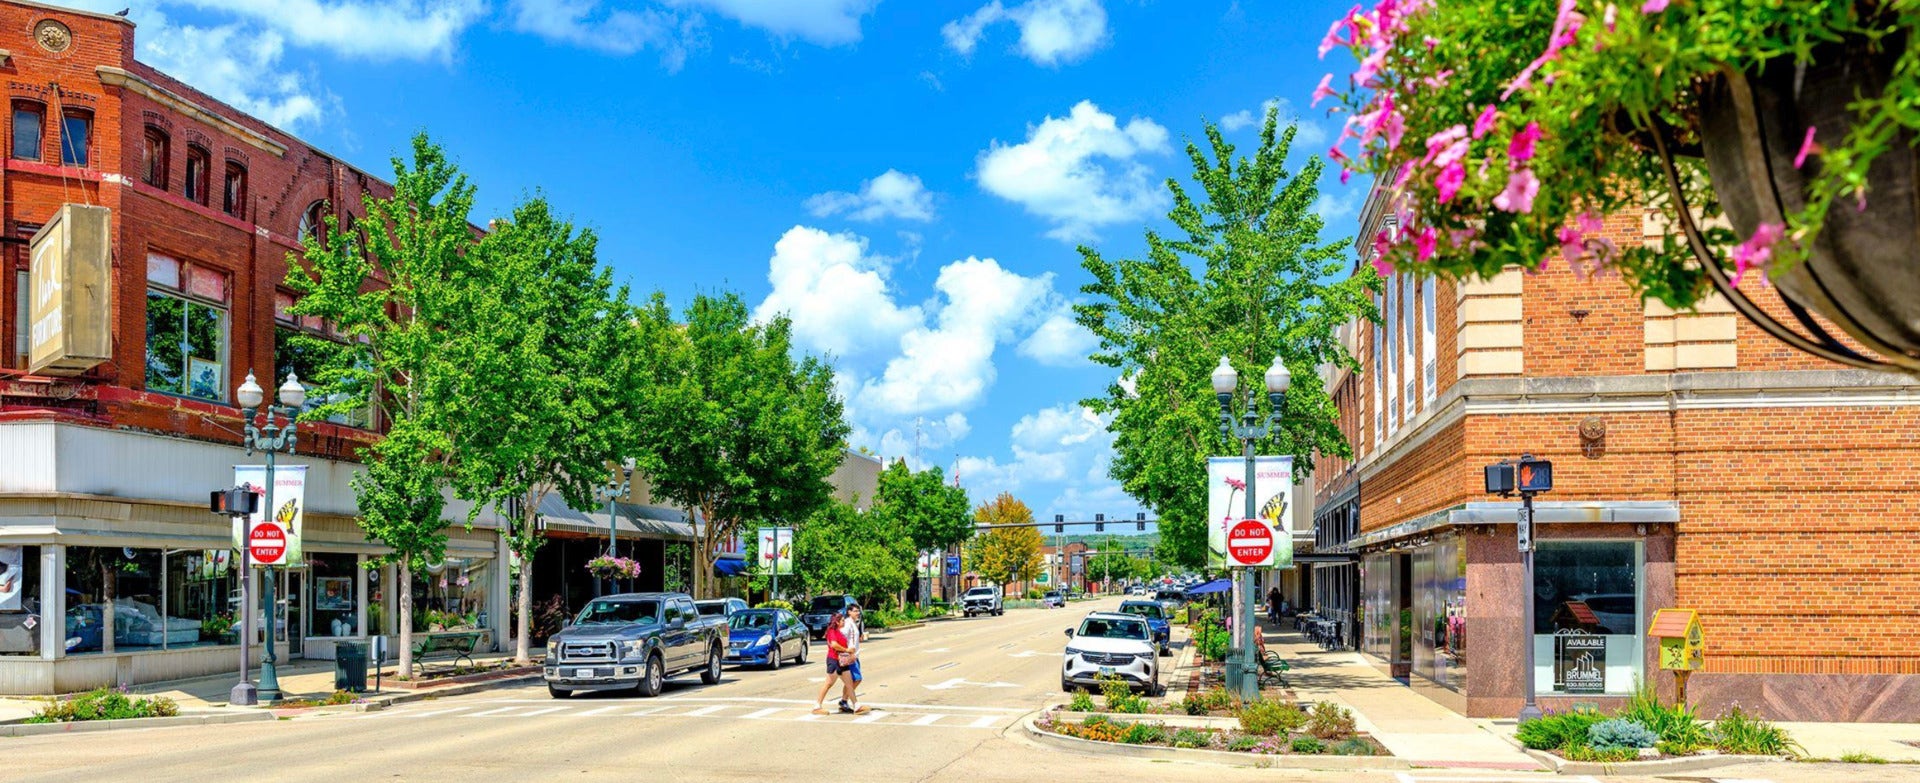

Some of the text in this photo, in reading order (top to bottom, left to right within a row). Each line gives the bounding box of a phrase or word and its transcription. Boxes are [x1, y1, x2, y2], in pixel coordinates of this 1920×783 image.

[1257, 471, 1290, 479] SUMMER
[254, 530, 280, 538] DO NOT
[1234, 528, 1265, 537] DO NOT
[256, 548, 278, 556] ENTER
[1237, 548, 1264, 556] ENTER
[1566, 671, 1603, 680] BRUMMEL
